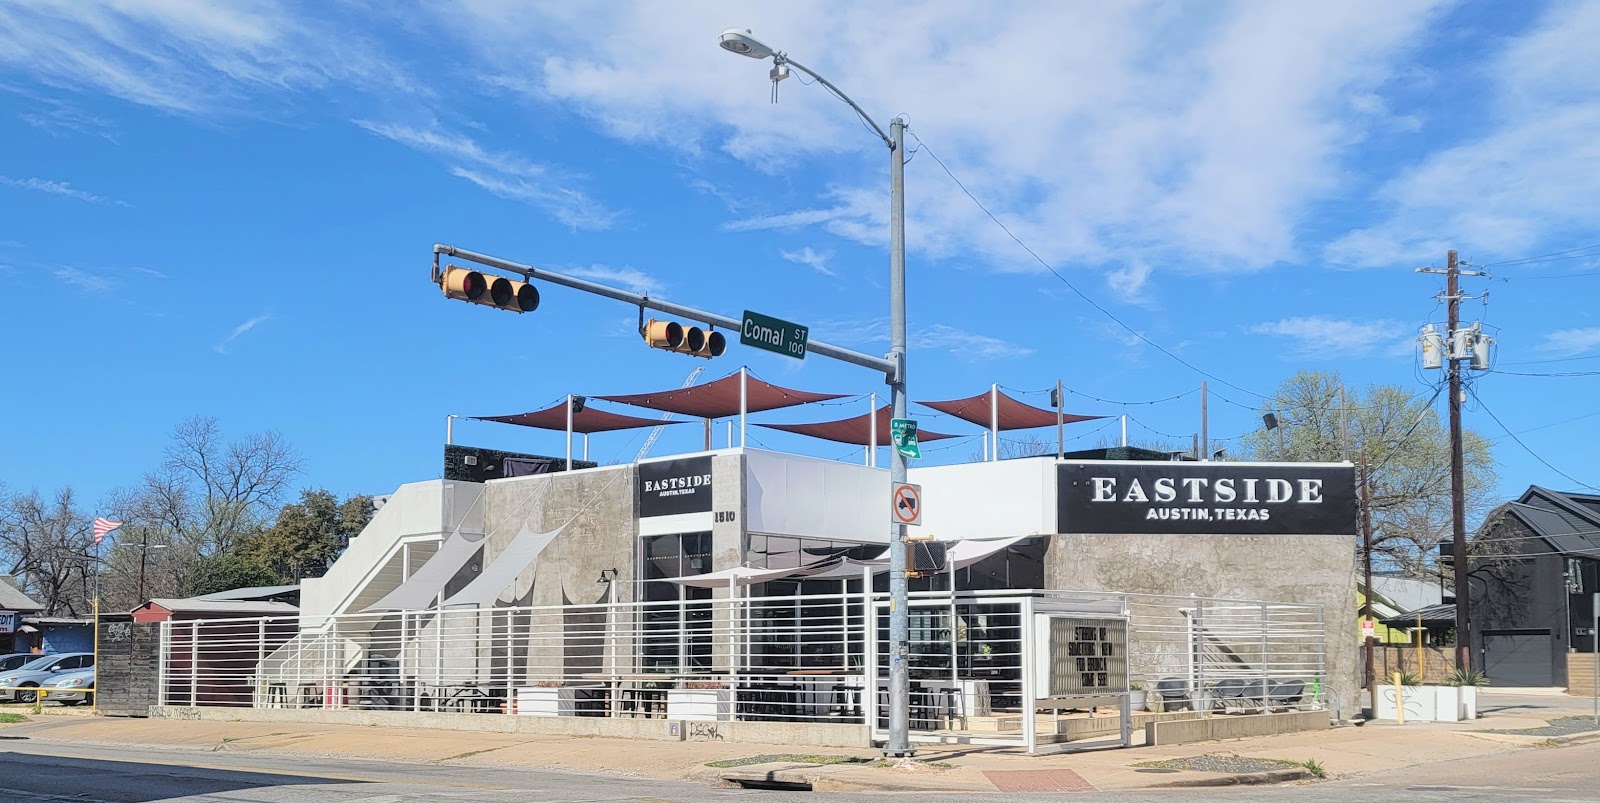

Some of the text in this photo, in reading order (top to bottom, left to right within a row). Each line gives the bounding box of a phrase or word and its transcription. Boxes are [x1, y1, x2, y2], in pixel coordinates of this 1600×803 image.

[744, 318, 807, 347] Comal ST
[788, 341, 804, 355] 100
[644, 474, 712, 492] EASTSIDE
[1091, 477, 1324, 503] EASTSIDE
[714, 510, 736, 523] 1510
